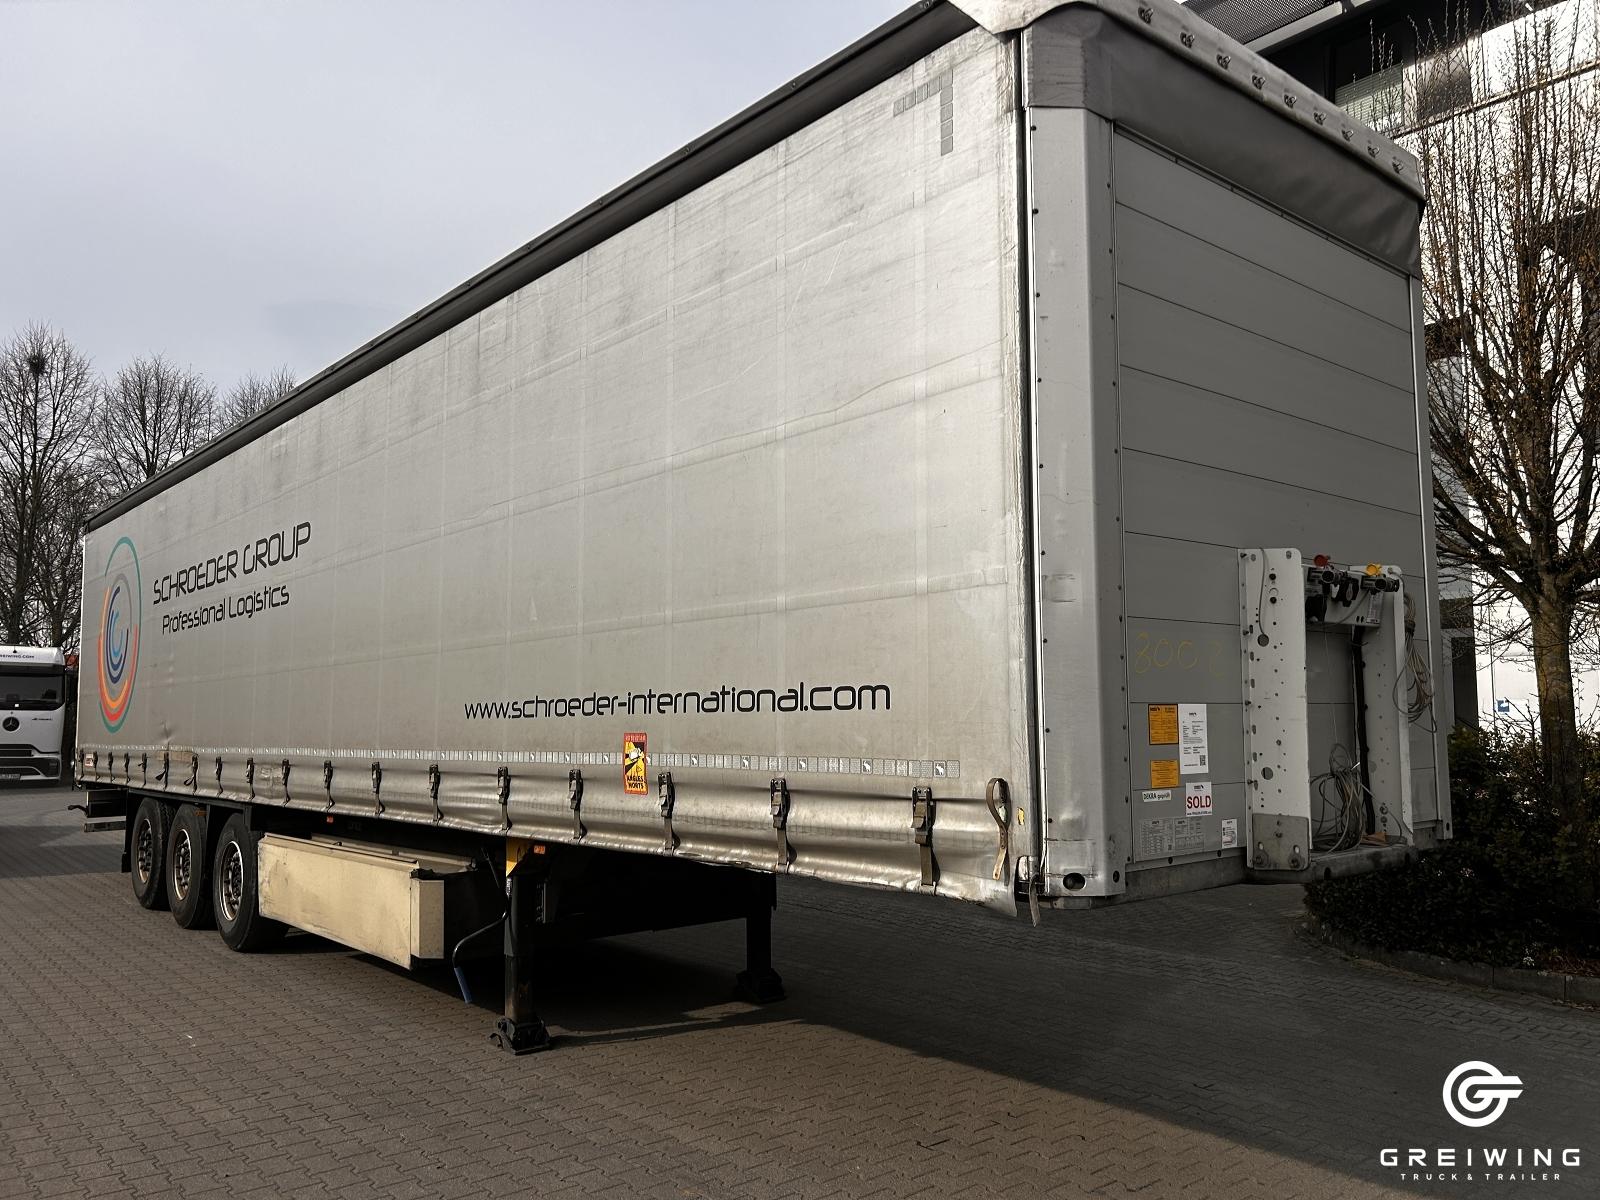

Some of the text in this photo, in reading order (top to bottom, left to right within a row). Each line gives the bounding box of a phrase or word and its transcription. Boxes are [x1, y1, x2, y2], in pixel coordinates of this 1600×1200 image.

[153, 521, 311, 605] SCHROEDER GROUP
[162, 585, 290, 635] Professional Logistics
[465, 682, 890, 720] www.schroeder-international.com
[1187, 795, 1211, 809] SOLD
